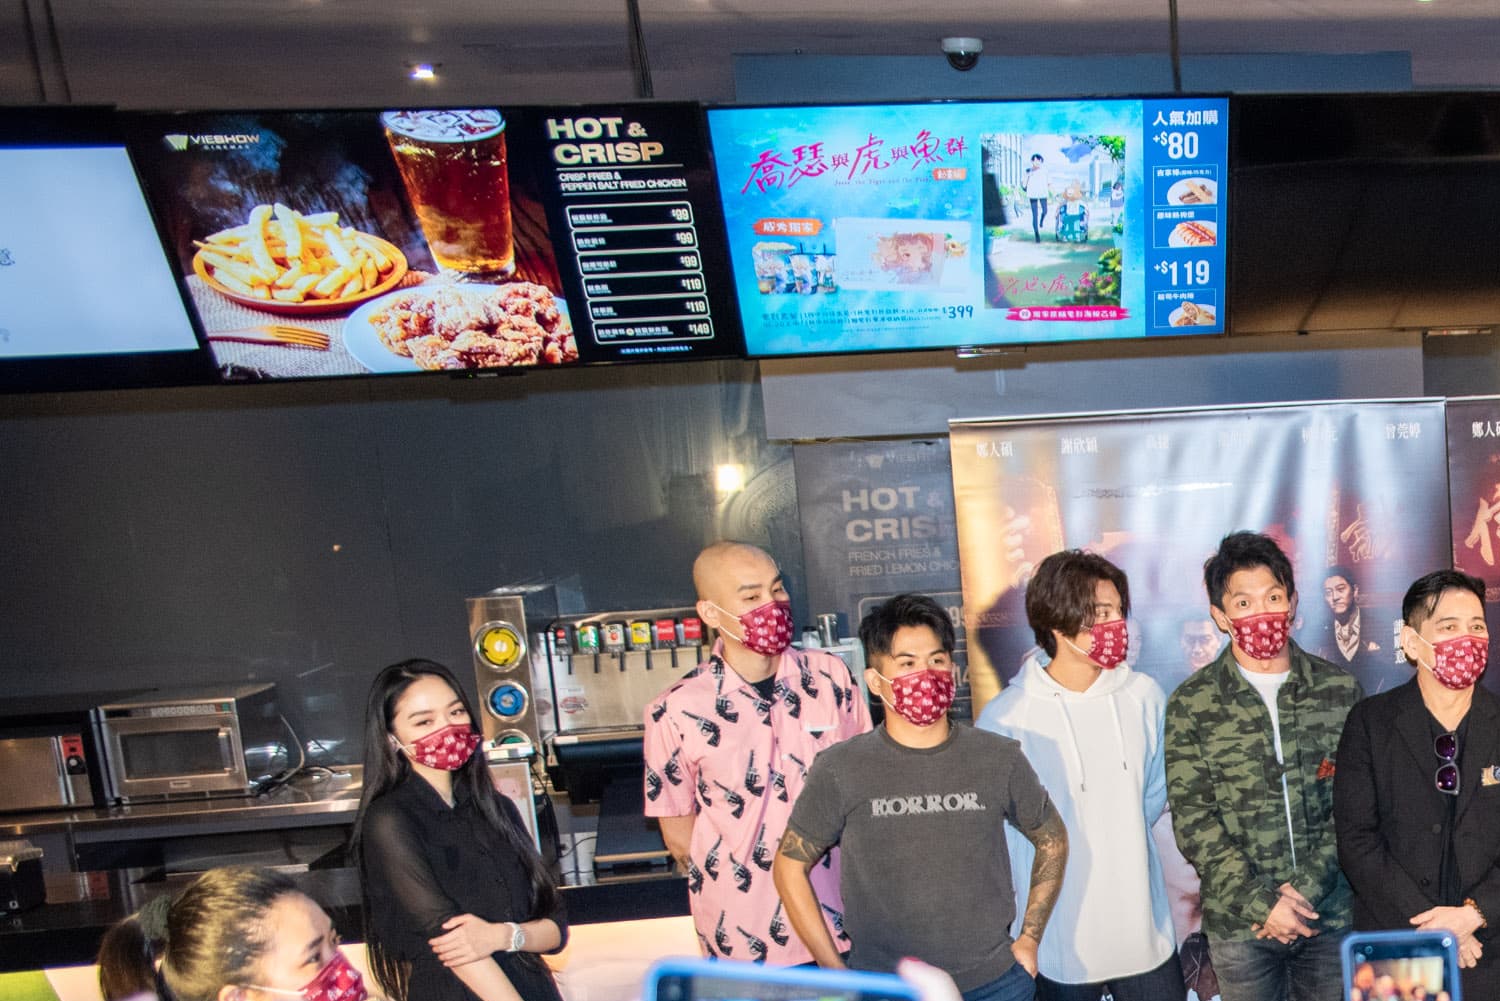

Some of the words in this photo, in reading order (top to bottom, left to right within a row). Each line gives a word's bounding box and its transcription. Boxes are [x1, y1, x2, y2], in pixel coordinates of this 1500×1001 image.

[1153, 110, 1218, 126] 人氣加購
[546, 117, 623, 140] HOT
[628, 122, 648, 138] &
[554, 141, 664, 165] CRISP
[561, 182, 598, 192] PEPPER
[598, 181, 620, 191] SALT
[647, 178, 687, 189] CHICKEN
[841, 486, 920, 512] HOT
[848, 550, 896, 561] FRENCH
[849, 565, 883, 577] FRIED
[885, 562, 927, 574] LEMON
